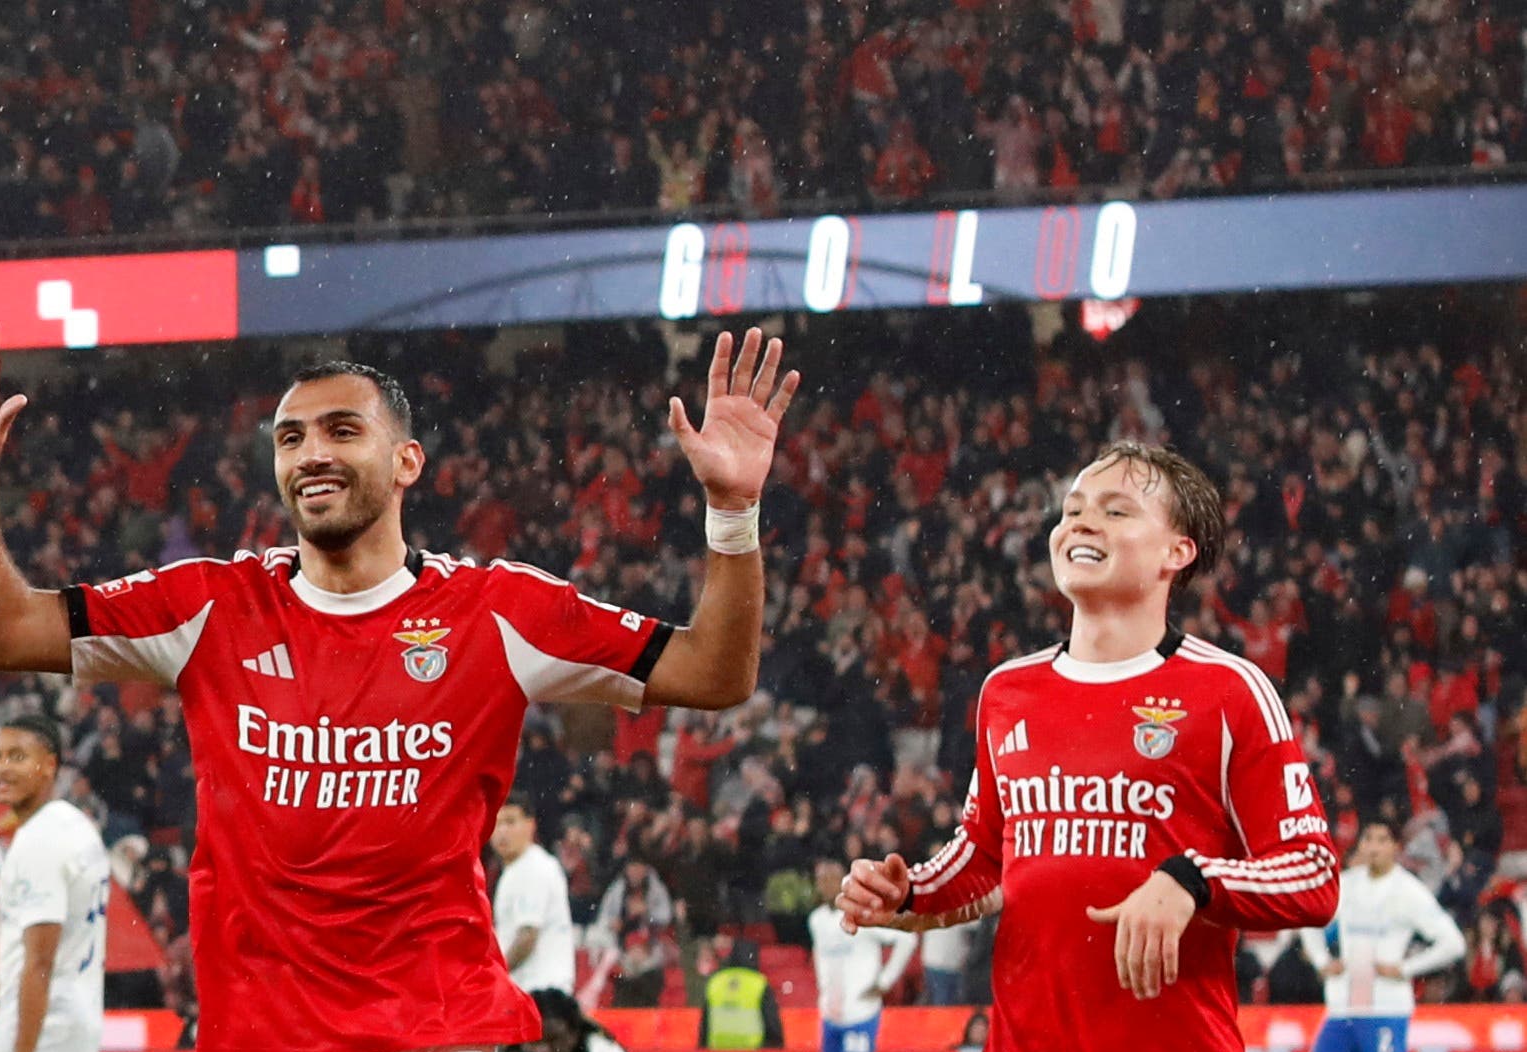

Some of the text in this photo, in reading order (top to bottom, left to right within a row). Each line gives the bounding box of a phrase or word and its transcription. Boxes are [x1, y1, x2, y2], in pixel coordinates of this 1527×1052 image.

[237, 704, 453, 764] Emirates
[264, 765, 421, 809] FLY BETTER
[996, 765, 1176, 820] Emirates
[1014, 819, 1148, 859] FLY BETTER
